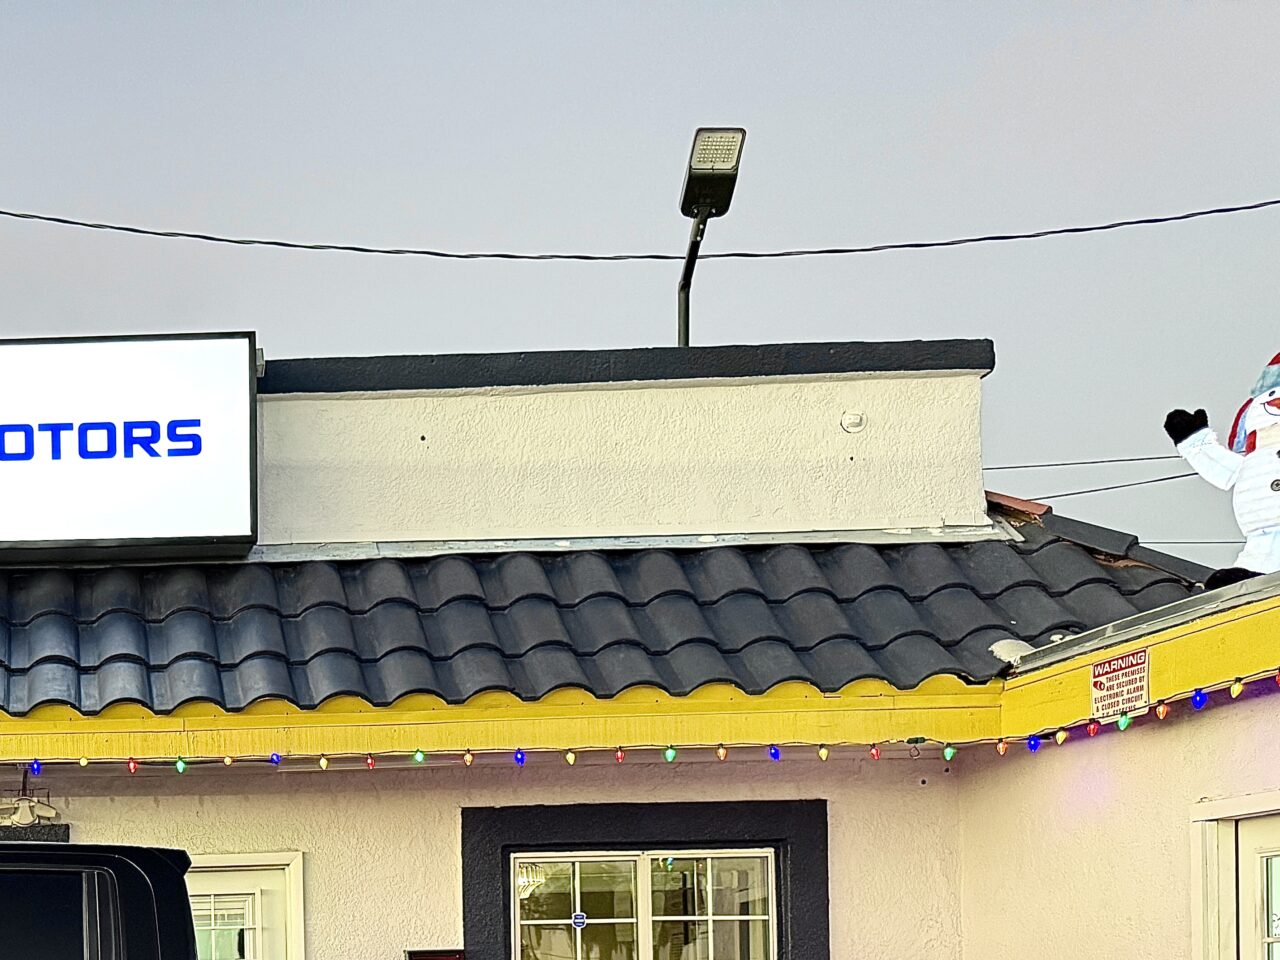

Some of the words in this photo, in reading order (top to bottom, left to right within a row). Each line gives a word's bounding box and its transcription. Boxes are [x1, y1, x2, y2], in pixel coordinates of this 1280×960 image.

[1094, 652, 1146, 676] WARNING
[1106, 673, 1120, 684] THESE
[1122, 666, 1146, 679] PREMISES
[1106, 684, 1115, 692] ARE
[1116, 678, 1138, 690] SECURED
[1094, 690, 1125, 704] ELECTRONIC
[1126, 685, 1144, 695] ALARM
[1101, 700, 1120, 711] CLOSED
[1121, 694, 1143, 705] CIRCUIT
